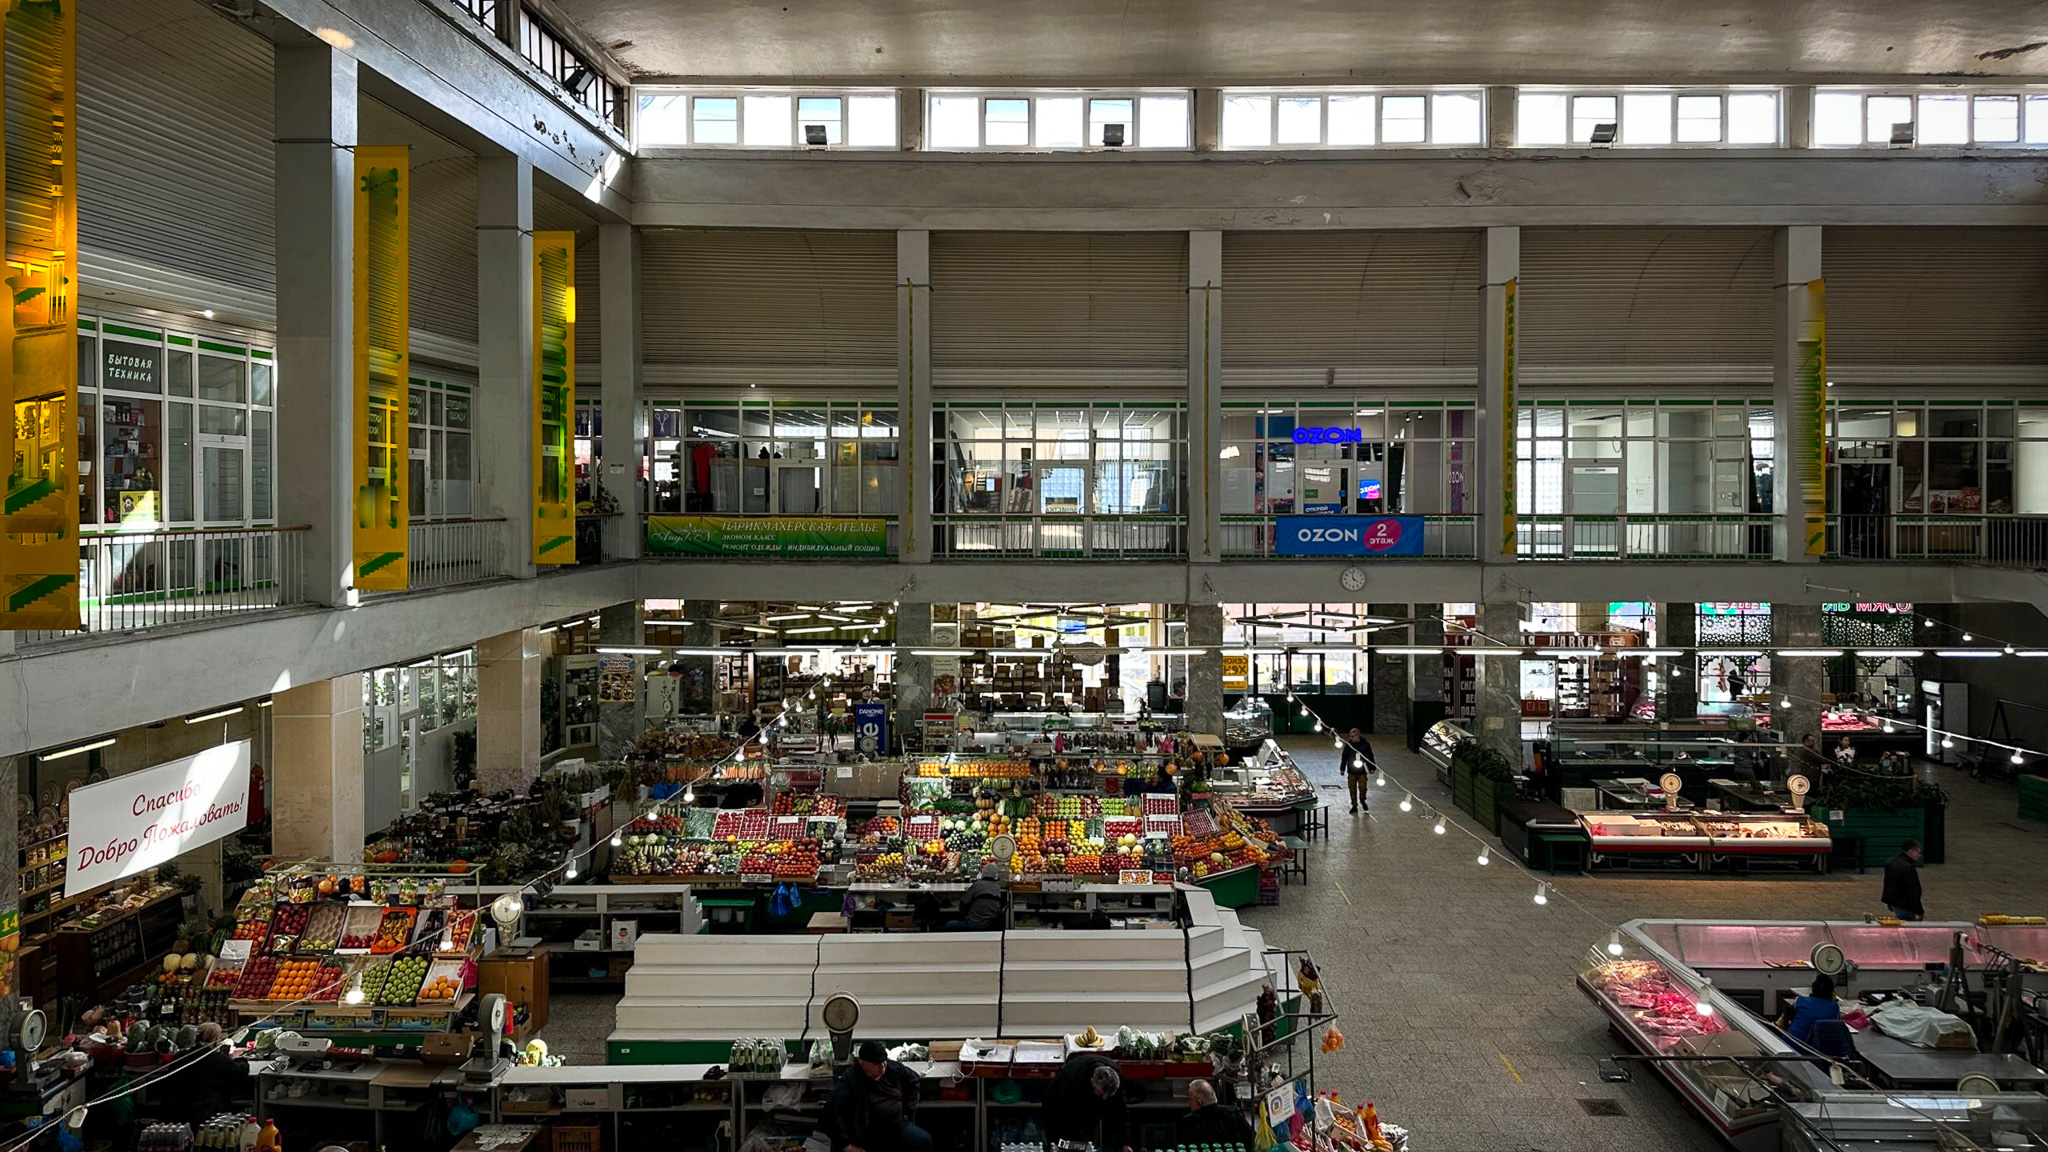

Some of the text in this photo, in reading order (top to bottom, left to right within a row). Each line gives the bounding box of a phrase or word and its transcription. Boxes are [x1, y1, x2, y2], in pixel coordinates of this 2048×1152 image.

[108, 353, 153, 369] БЫТОВАЯ
[108, 367, 153, 383] ТЕХНИКА
[1291, 426, 1362, 444] OZON
[1448, 471, 1464, 484] OZON
[1359, 483, 1381, 494] OZON
[1305, 505, 1329, 513] ОТКРОЙ
[1297, 528, 1358, 542] OZON
[1376, 523, 1387, 536] 2
[1369, 537, 1394, 545] этаж
[750, 544, 782, 552] ОДЕЖДЫ
[787, 544, 853, 552] ИНДИВИДУАЛЬНЫЙ
[1549, 635, 1594, 648] ЛАВКА
[77, 792, 245, 871] Добро Пожаловать!
[2, 913, 19, 933] 14
